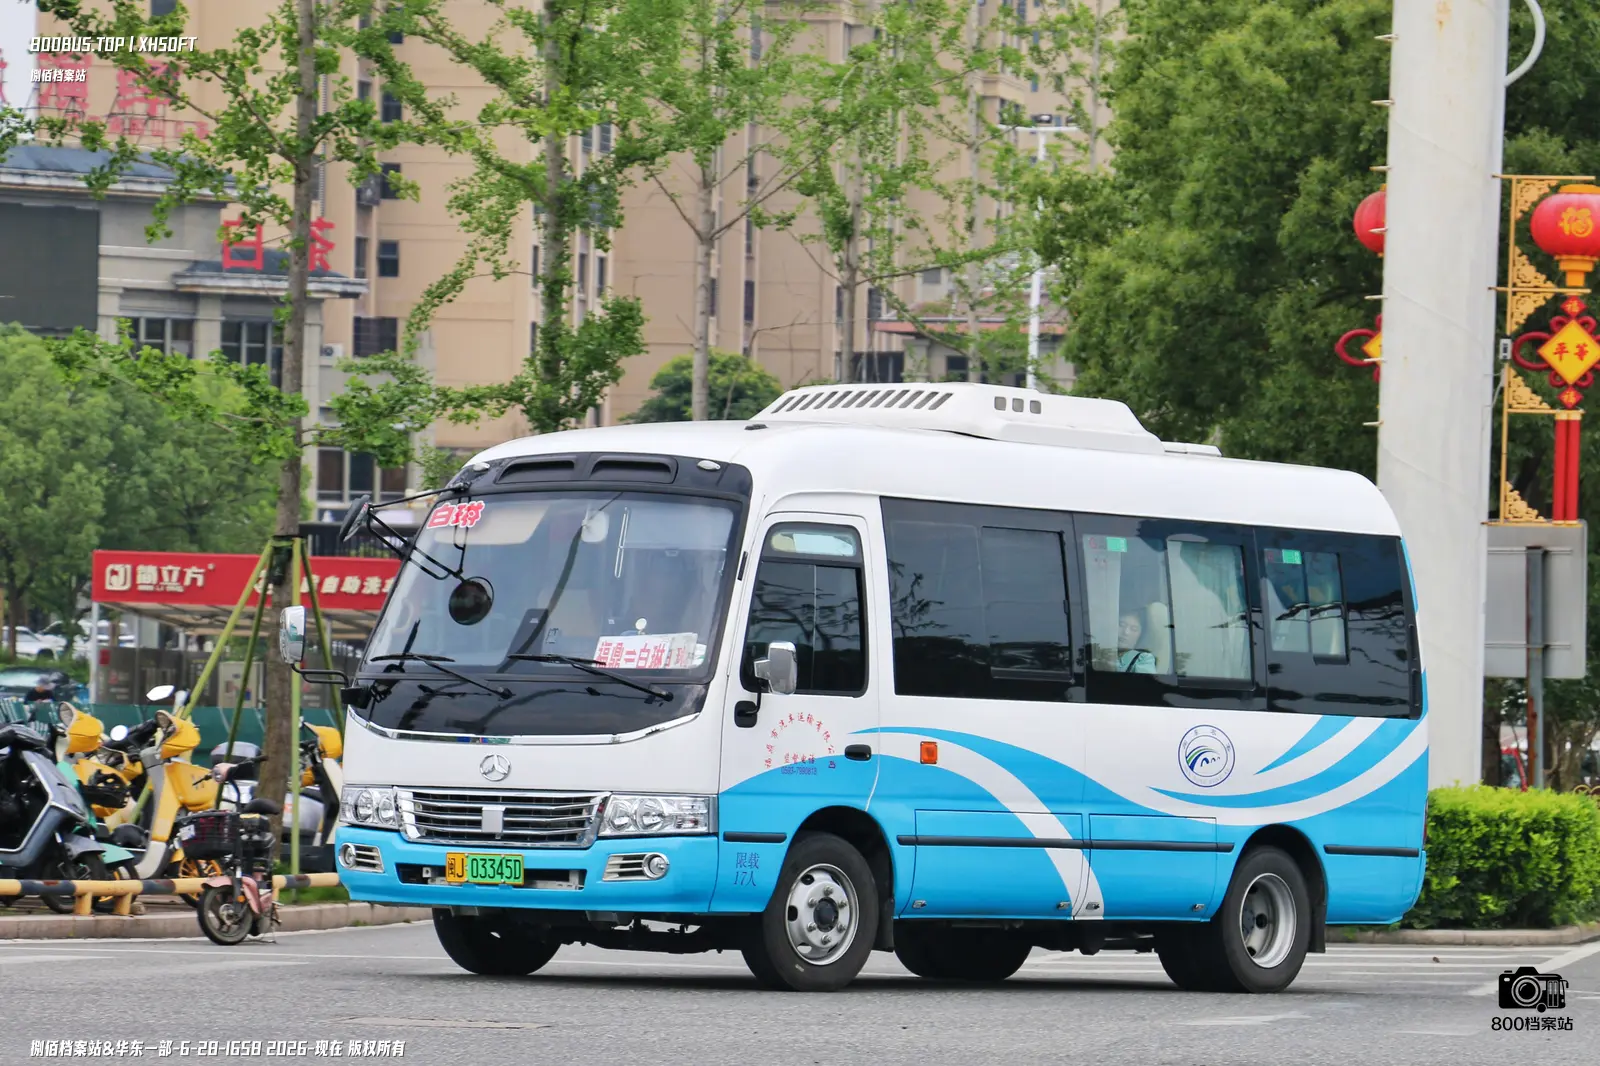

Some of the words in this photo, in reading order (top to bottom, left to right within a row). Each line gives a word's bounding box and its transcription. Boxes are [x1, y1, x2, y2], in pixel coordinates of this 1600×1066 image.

[471, 858, 522, 880] 03345D
[735, 851, 760, 870] 限载
[733, 870, 757, 887] 17人
